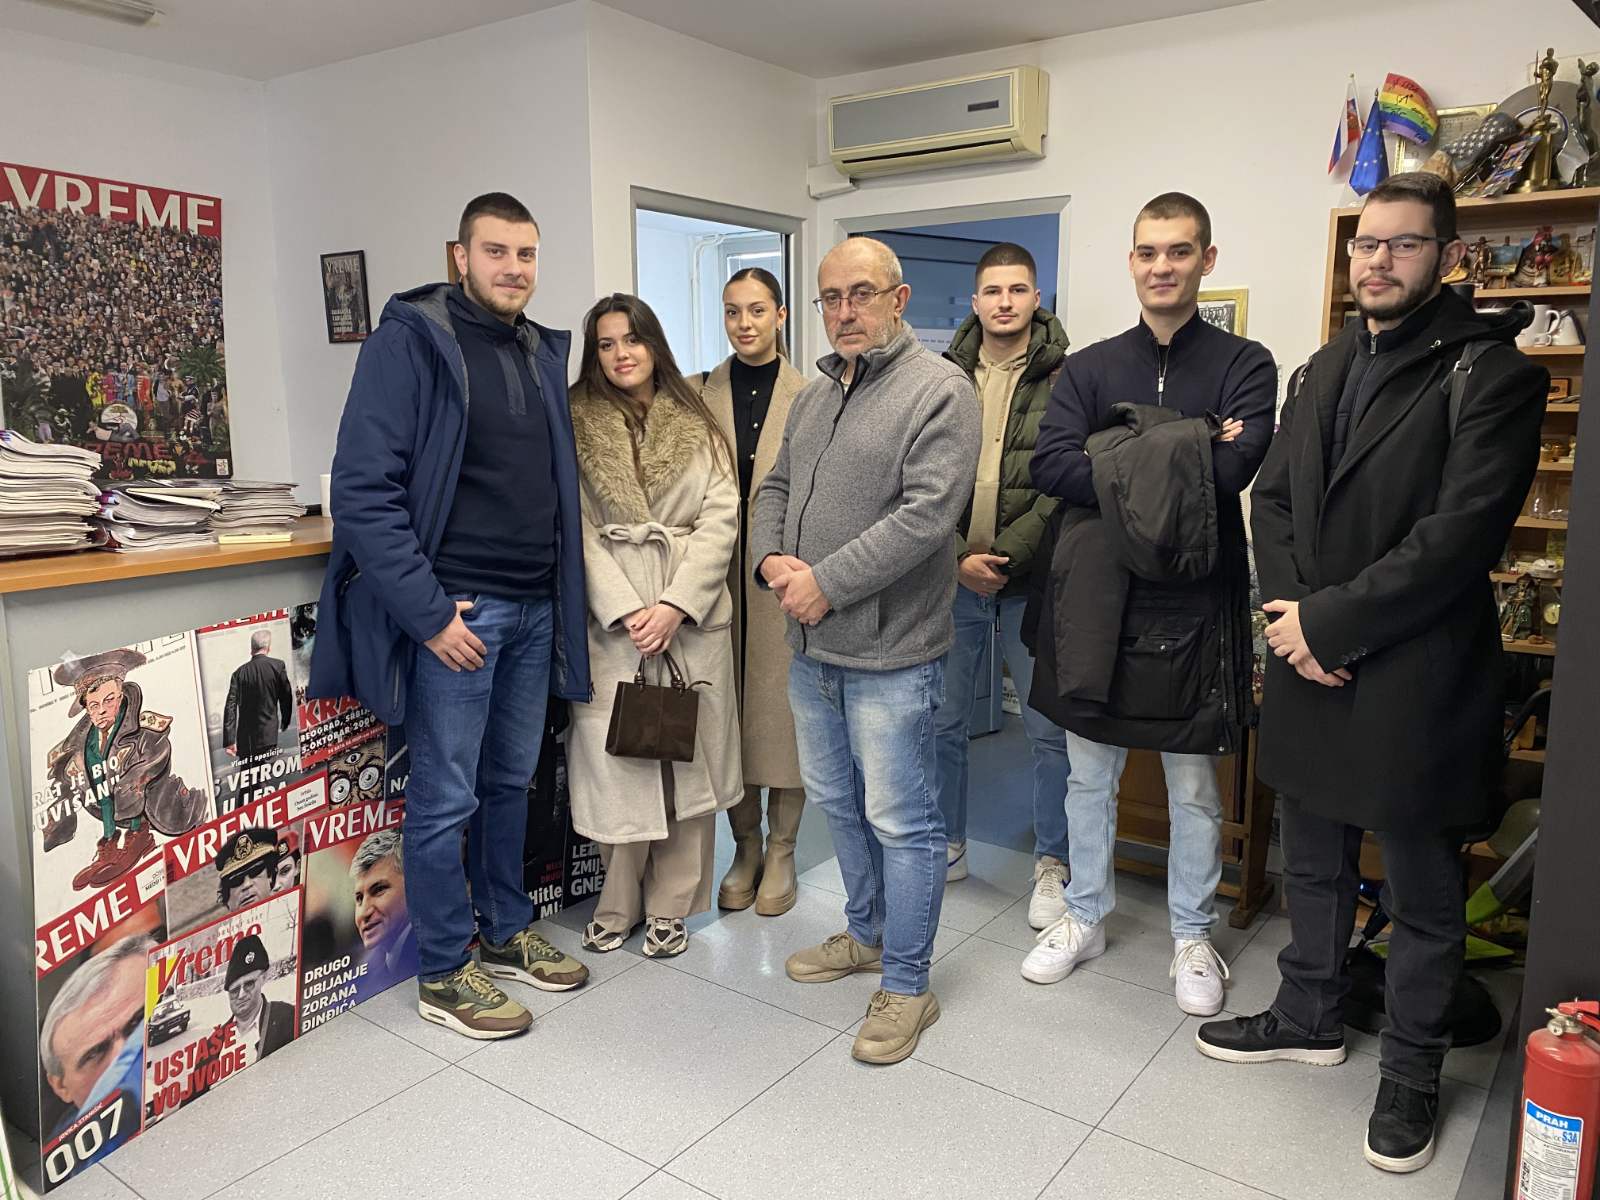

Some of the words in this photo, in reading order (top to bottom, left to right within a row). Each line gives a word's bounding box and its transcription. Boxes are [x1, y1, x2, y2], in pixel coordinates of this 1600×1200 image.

[4, 167, 214, 236] VREME
[353, 714, 377, 730] 2000
[70, 771, 86, 790] JE
[92, 756, 119, 779] BIO
[227, 754, 301, 792] VETROM
[231, 757, 248, 768] Vlast
[254, 747, 283, 761] opozicija
[172, 796, 284, 874] VREME
[309, 800, 400, 848] VREME
[570, 874, 606, 896] GNE
[303, 962, 369, 999] UBIJANJE
[304, 955, 351, 984] DRUGO
[302, 983, 357, 1017] ZORANA
[153, 1021, 238, 1086] USTAŠE
[152, 1044, 247, 1117] VOJVODE
[1535, 1110, 1569, 1129] PRAH
[45, 1097, 124, 1183] 007
